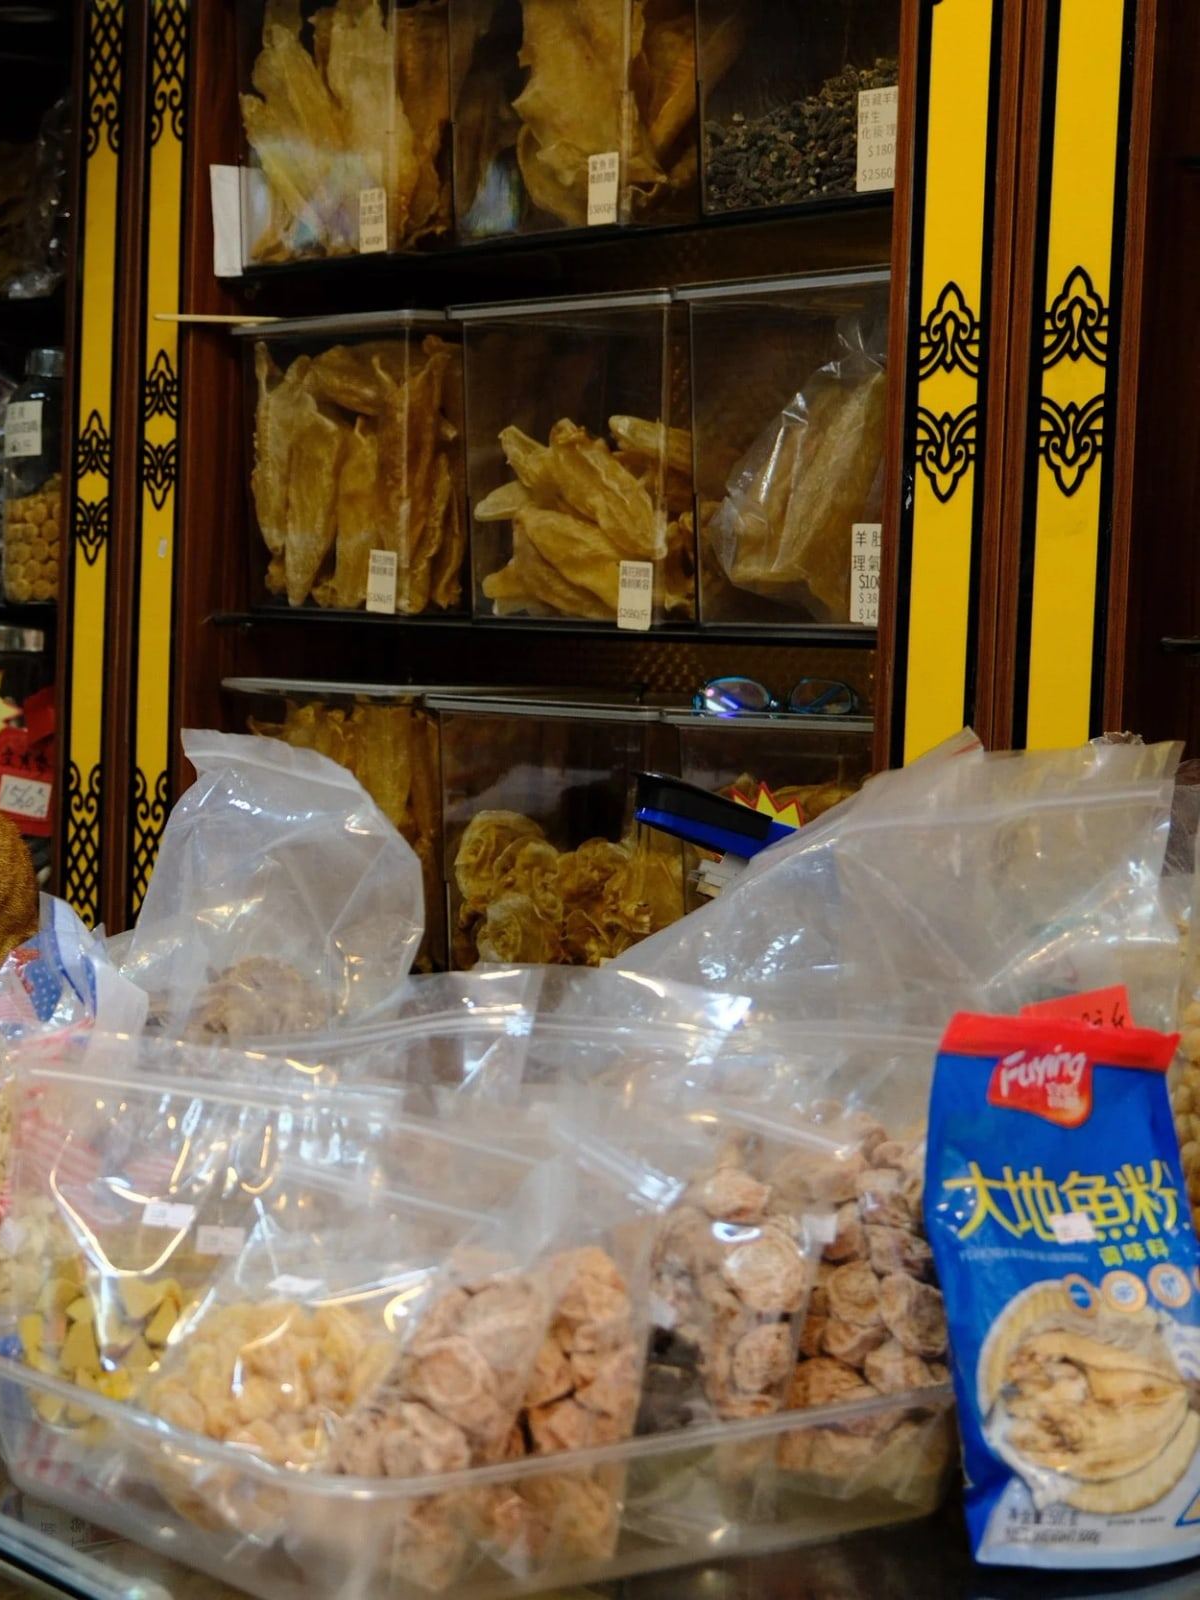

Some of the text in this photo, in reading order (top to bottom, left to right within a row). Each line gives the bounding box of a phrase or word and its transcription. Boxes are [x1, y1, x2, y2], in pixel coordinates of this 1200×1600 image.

[999, 1043, 1088, 1098] Fuying
[943, 1158, 1178, 1242] 大地魚粉
